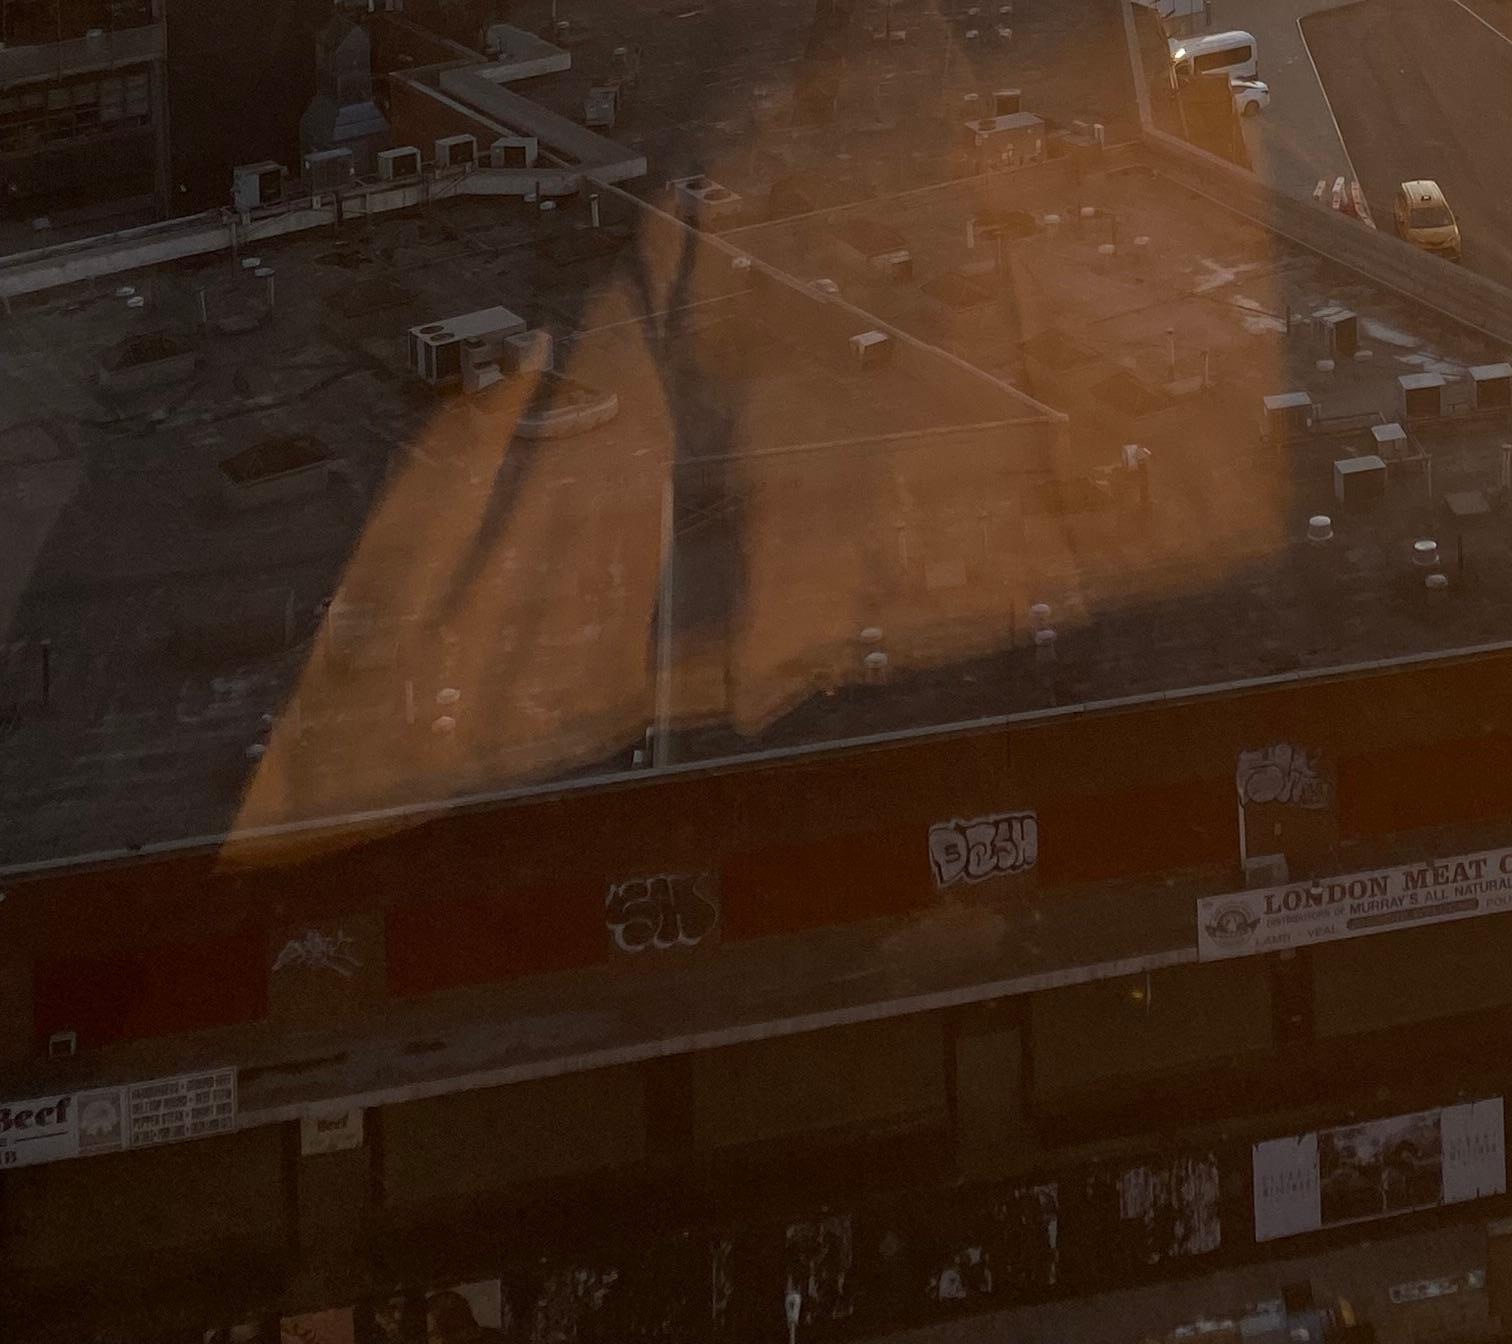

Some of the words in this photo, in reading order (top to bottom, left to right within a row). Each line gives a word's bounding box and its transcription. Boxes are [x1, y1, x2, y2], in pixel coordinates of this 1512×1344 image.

[1263, 875, 1390, 915] LONDON
[1401, 858, 1488, 892] MEAT
[1349, 894, 1420, 915] MURRAY'S
[1423, 888, 1450, 904] ALL
